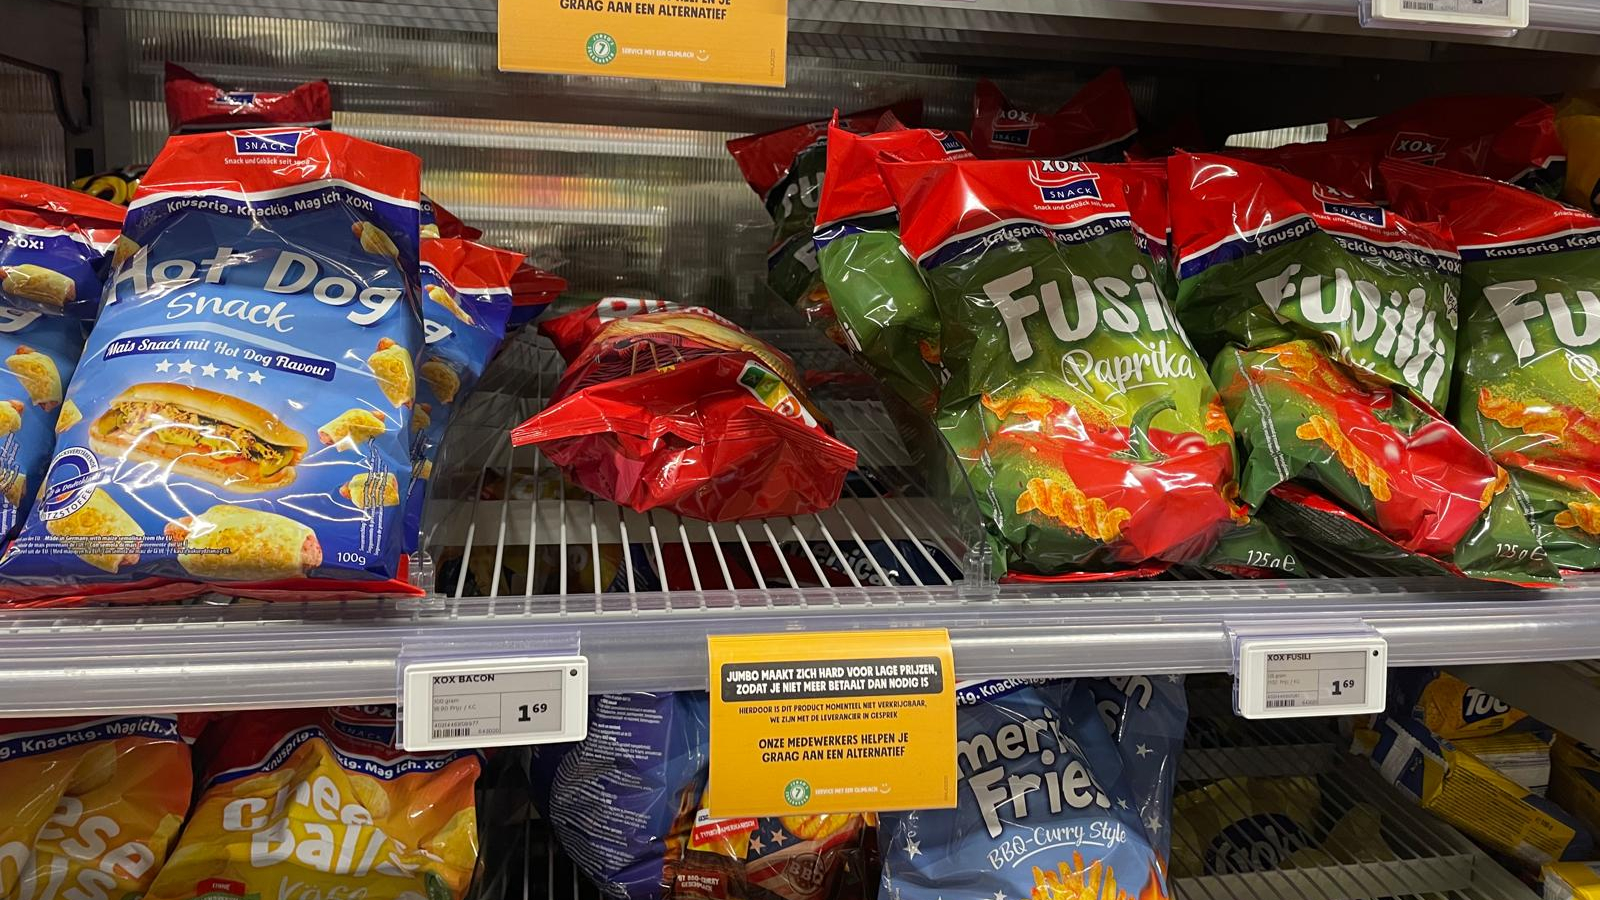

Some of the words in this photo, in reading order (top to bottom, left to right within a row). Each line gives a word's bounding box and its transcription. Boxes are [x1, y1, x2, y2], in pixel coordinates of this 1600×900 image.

[560, 0, 604, 11] GRAAG
[608, 4, 632, 14] AAN
[636, 4, 654, 15] EEN
[658, 5, 727, 20] ALTERNATIEF
[598, 43, 606, 54] 7
[622, 47, 644, 56] SERVICE
[245, 141, 287, 151] SNACK
[1396, 140, 1436, 154] XOX
[224, 157, 244, 165] Snack
[256, 157, 278, 165] Gebäck
[279, 157, 292, 165] seit
[1050, 188, 1092, 198] SNACK
[167, 198, 233, 214] Knusprig.
[236, 204, 293, 218] Knackig.
[294, 196, 321, 212] Mag
[322, 190, 341, 205] ich
[346, 193, 373, 211] XOX!
[1332, 206, 1375, 222] SNACK
[1053, 224, 1108, 242] Knackig.
[1256, 218, 1318, 248] Knuspri
[7, 236, 44, 250] XOX!
[1486, 244, 1564, 258] Knusprig.
[106, 244, 234, 306] Hot
[264, 250, 402, 326] Dog
[167, 292, 297, 333] Snack
[106, 340, 136, 357] Mais
[138, 338, 182, 352] Snack
[184, 339, 210, 352] mit
[214, 341, 240, 358] Hot
[244, 348, 272, 366] Dog
[276, 354, 330, 377] Flavour
[1061, 340, 1198, 393] Paprika
[337, 552, 366, 566] 100g
[433, 676, 456, 684] XOX
[458, 674, 494, 683] BACON
[726, 670, 759, 682] JUMBO
[761, 668, 794, 680] MAAKT
[796, 667, 817, 680] ZICH
[818, 666, 844, 678] HARD
[846, 666, 874, 678] VOOR
[875, 664, 898, 676] LAGE
[900, 664, 938, 676] PRIJZEN,
[736, 683, 768, 695] ZODAT
[770, 683, 781, 694] JE
[782, 682, 801, 693] NIET
[803, 680, 826, 692] MEER
[828, 679, 866, 691] BETAALT
[868, 678, 888, 690] DAN
[889, 677, 919, 689] NODIG
[920, 678, 929, 688] IS
[739, 706, 772, 715] HIERDOOR
[774, 706, 780, 714] IS
[782, 704, 792, 713] DIT
[794, 704, 824, 712] PRODUCT
[826, 702, 861, 711] MOMENTEEL
[863, 701, 876, 710] NIET
[878, 700, 927, 709] VERKRIJGBAAR,
[782, 716, 796, 724] ZIJN
[797, 715, 809, 723] MET
[811, 714, 819, 722] DE
[820, 712, 861, 722] LEVERANCIER
[863, 712, 869, 720] IN
[871, 711, 898, 719] GESPREK
[22, 730, 102, 752] Knackig.
[106, 722, 136, 735] Mag
[758, 738, 785, 749] ONZE
[787, 736, 858, 748] MEDEWERKERS
[861, 734, 895, 744] HELPEN
[897, 733, 909, 744] JE
[762, 752, 799, 763] GRAAG
[802, 750, 824, 761] AAN
[826, 750, 844, 759] EEN
[846, 746, 905, 759] ALTERNATIEF
[365, 762, 394, 780] Mag
[396, 760, 420, 774] ich.
[986, 824, 1085, 871] BBQ-Curry
[1090, 821, 1128, 849] Style
